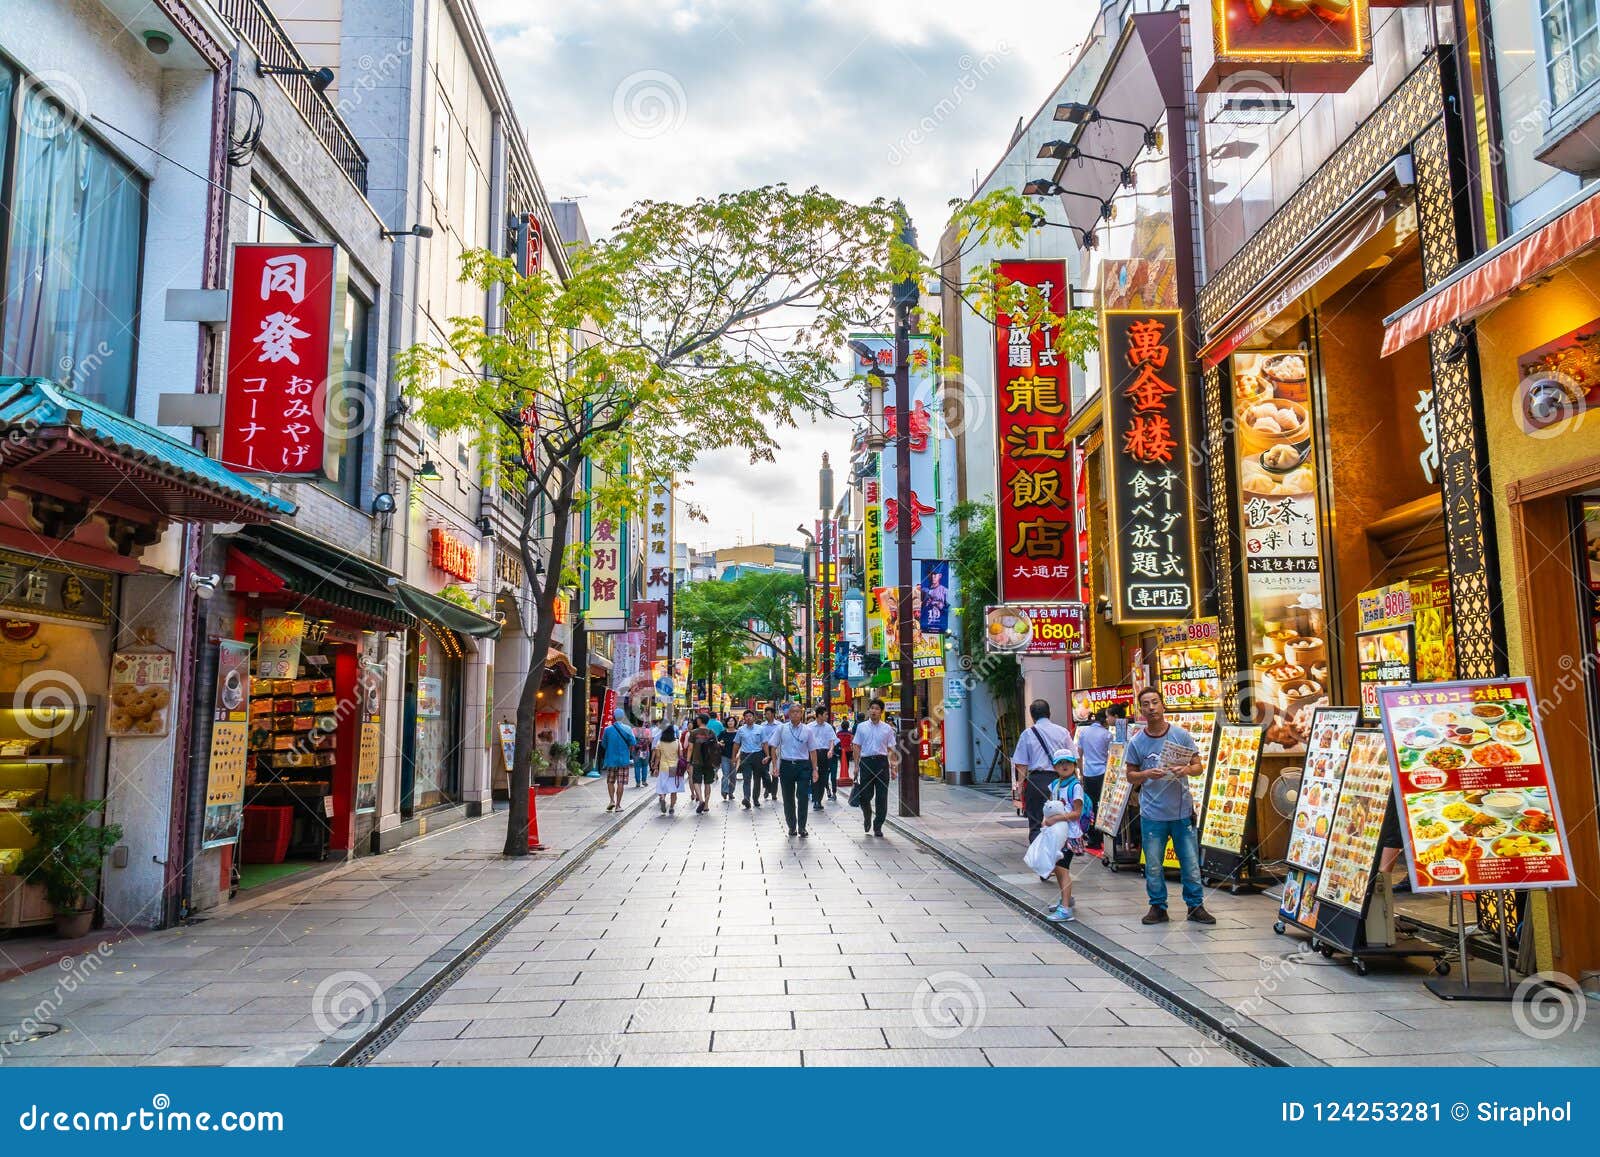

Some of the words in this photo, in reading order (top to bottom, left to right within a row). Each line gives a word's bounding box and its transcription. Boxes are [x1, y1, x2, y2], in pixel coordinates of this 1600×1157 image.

[253, 254, 312, 366] 同發
[238, 376, 268, 467] コーナー
[281, 374, 312, 467] おみやげ
[1005, 375, 1070, 559] 龍江飯店
[1245, 498, 1314, 526] 飲茶を
[1127, 471, 1161, 578] 食べ放題
[1158, 469, 1185, 577] オーダー式
[1261, 529, 1316, 551] 楽しむ
[1012, 563, 1070, 580] 大通店
[1031, 623, 1080, 640] 1680円
[1398, 686, 1513, 707] おすすめコース料理
